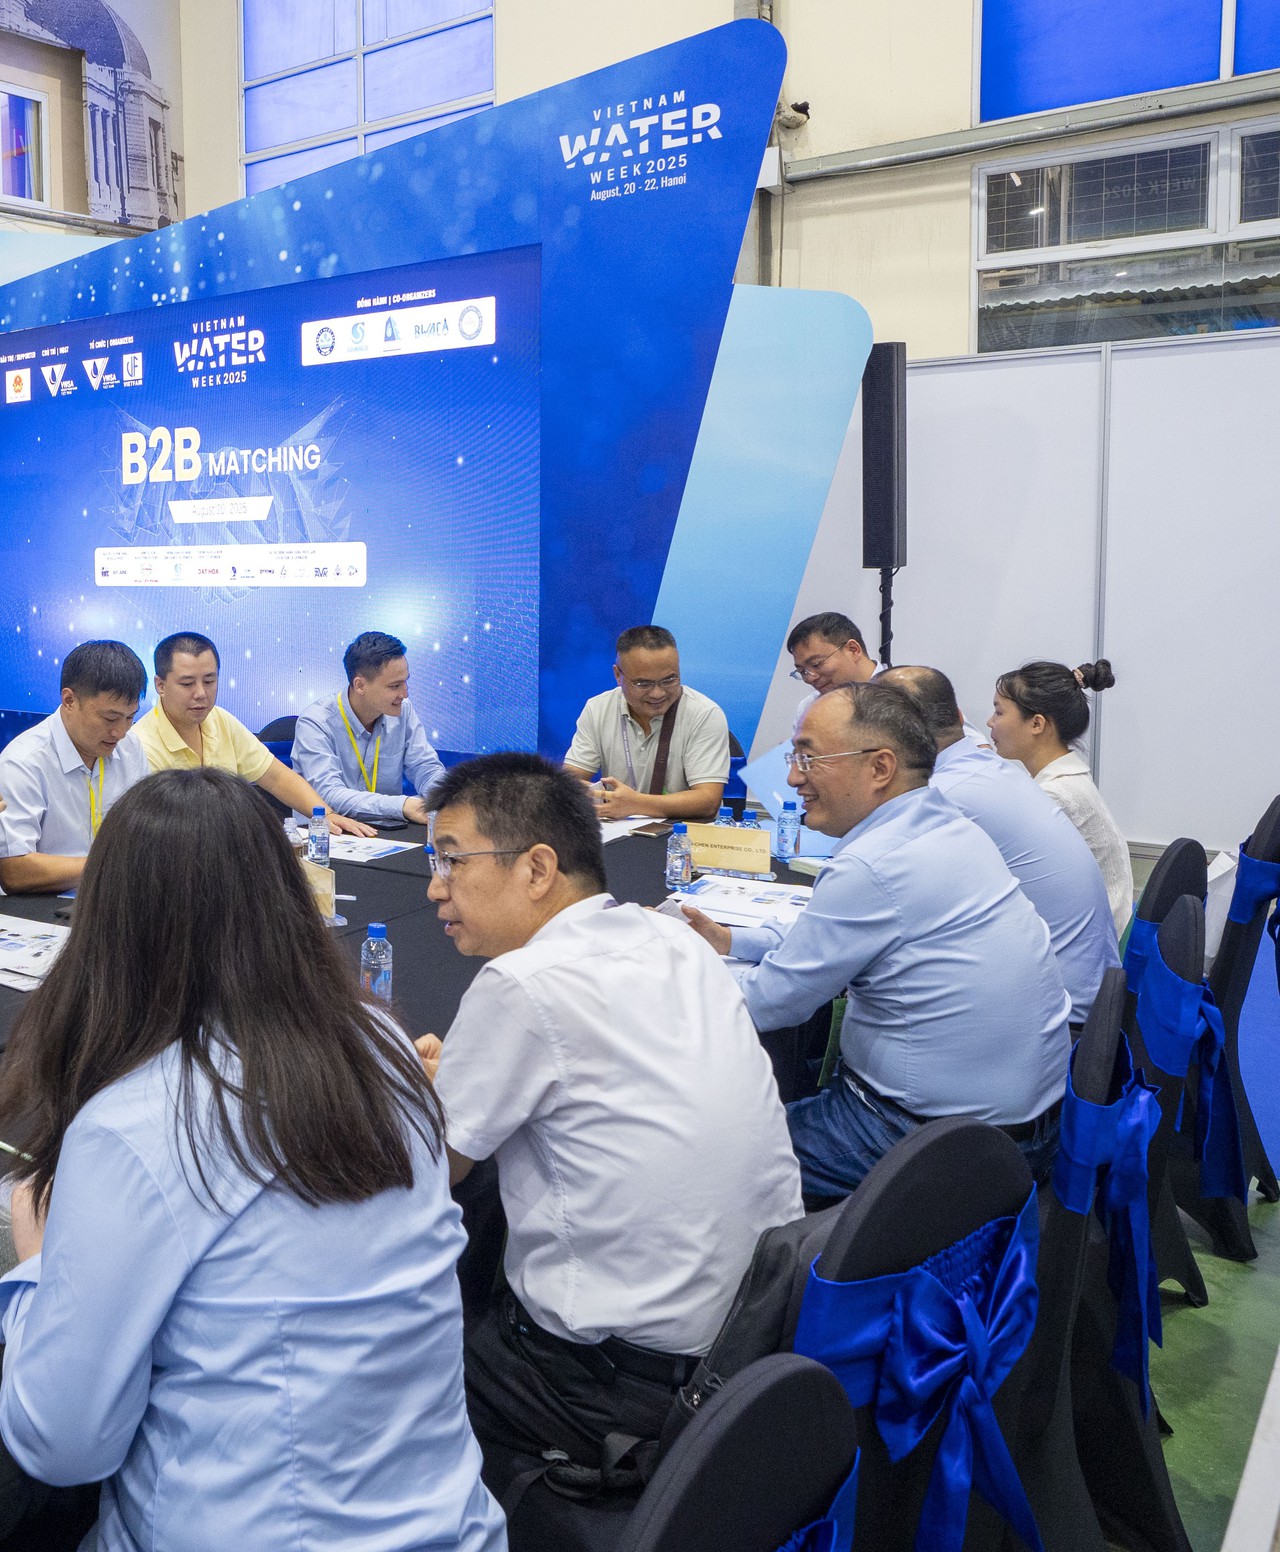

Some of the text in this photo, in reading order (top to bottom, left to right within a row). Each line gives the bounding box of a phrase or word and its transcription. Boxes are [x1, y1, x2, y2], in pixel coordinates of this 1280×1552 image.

[593, 90, 686, 121] VIETNAM
[558, 103, 723, 169] WATER
[590, 185, 622, 201] August,
[624, 182, 636, 196] 20
[644, 178, 659, 191] 22,
[661, 172, 687, 187] Hanoi
[192, 315, 245, 334] VIETNAM
[173, 329, 266, 373] WATER
[121, 426, 321, 485] B2B MATCHING
[709, 843, 743, 852] ENTERPRISE
